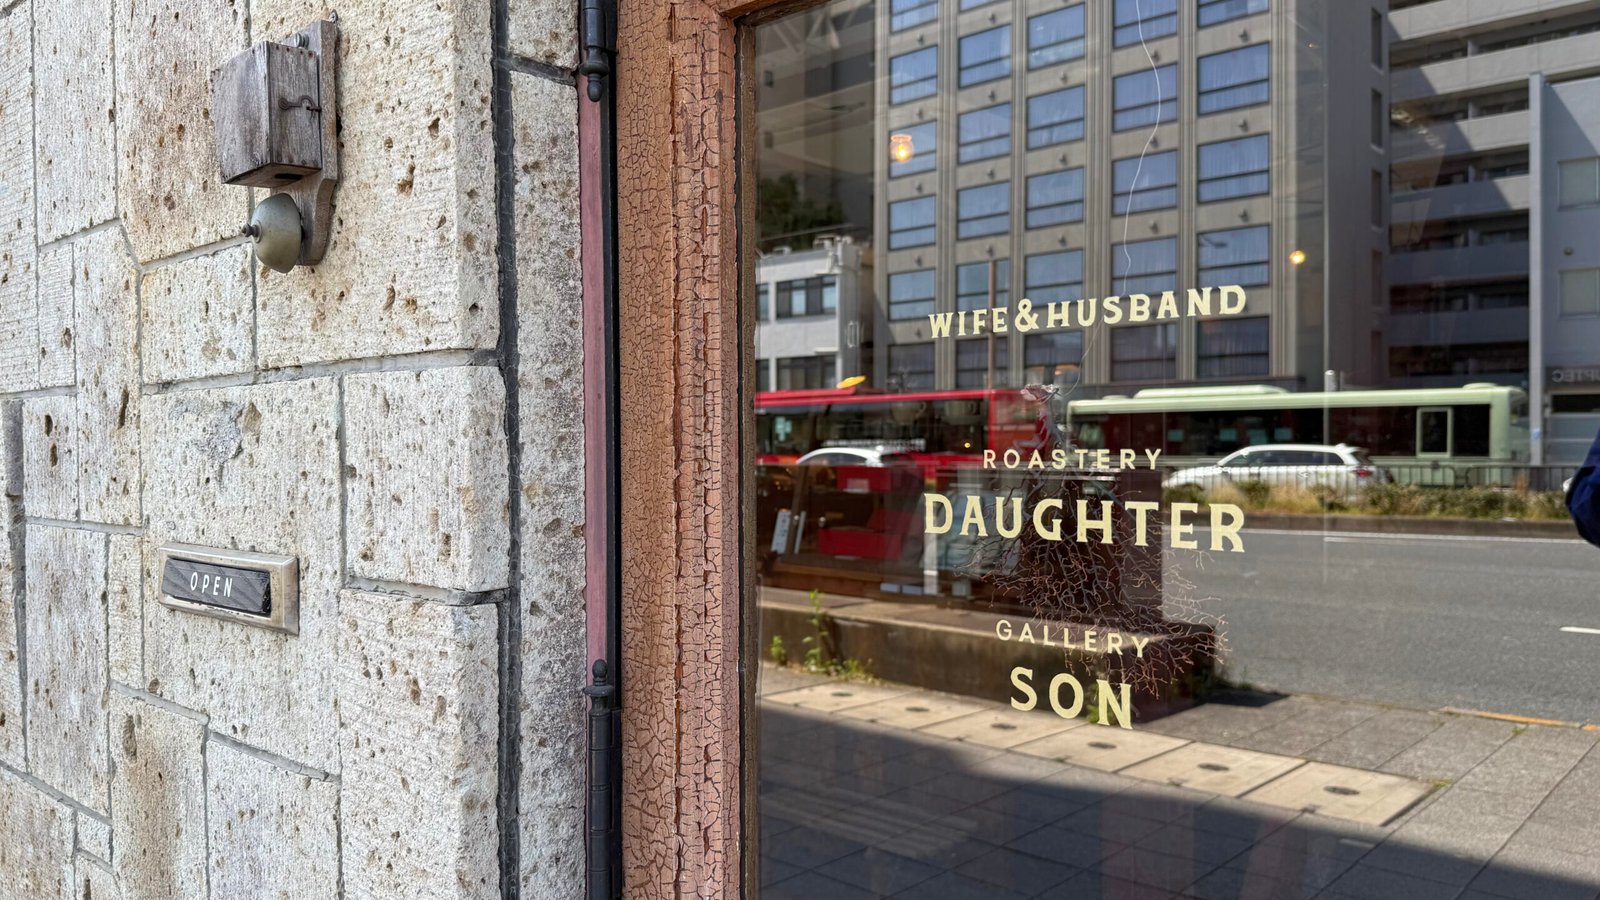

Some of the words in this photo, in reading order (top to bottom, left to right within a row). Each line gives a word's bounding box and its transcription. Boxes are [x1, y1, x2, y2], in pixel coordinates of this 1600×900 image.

[983, 449, 1162, 469] ROASTERY
[924, 493, 1245, 553] DAUGHTER
[190, 571, 233, 597] OPEN
[996, 619, 1149, 658] GALLERY
[1010, 666, 1133, 729] SON
